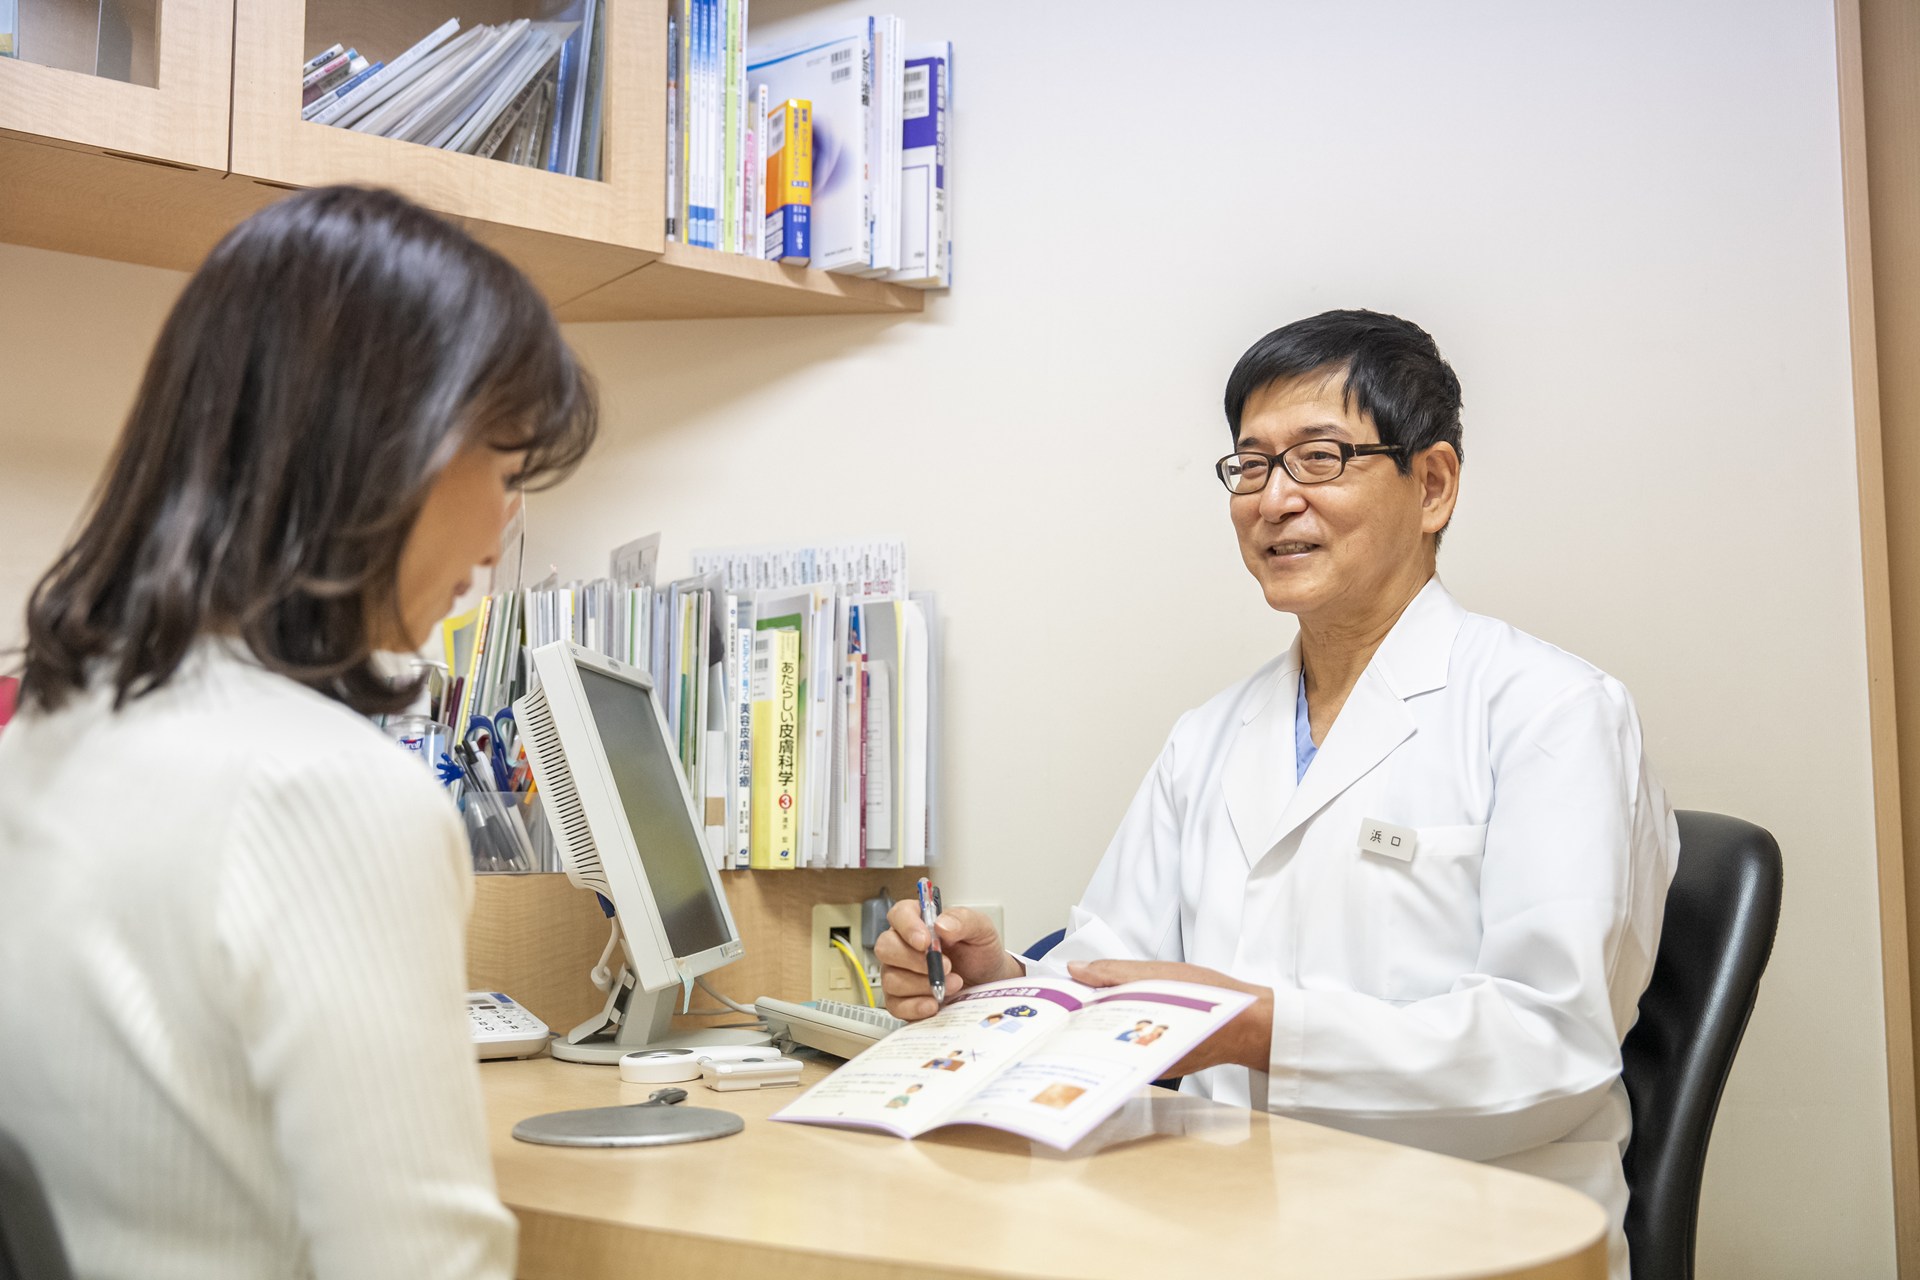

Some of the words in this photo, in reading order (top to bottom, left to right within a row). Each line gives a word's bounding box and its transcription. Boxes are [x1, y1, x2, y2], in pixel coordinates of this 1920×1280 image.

[738, 703, 750, 788] 美容皮膚科治療
[778, 661, 795, 787] あたらしい皮膚科学
[1370, 829, 1401, 847] 浜口
